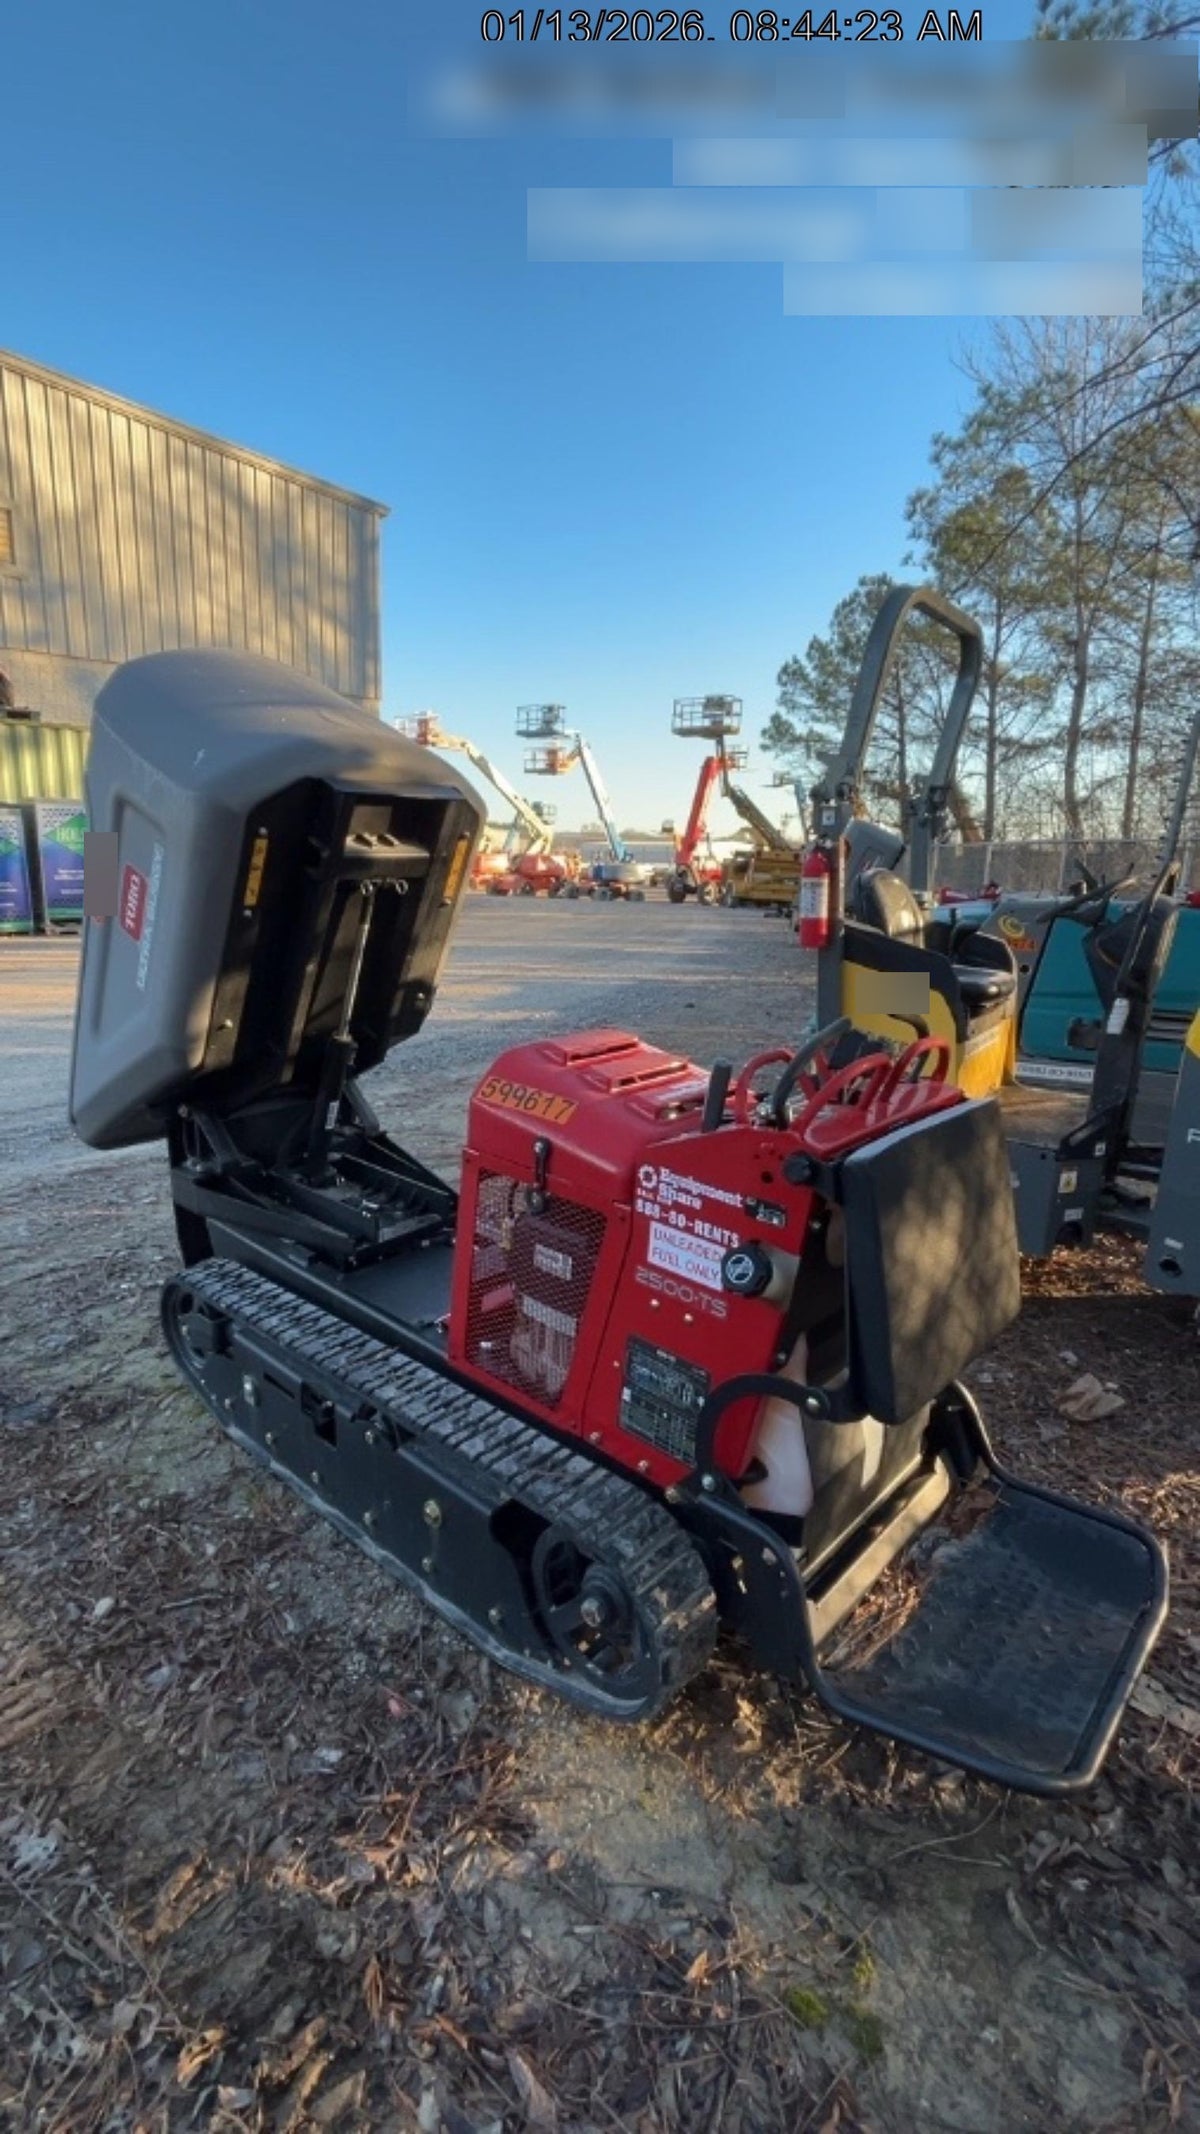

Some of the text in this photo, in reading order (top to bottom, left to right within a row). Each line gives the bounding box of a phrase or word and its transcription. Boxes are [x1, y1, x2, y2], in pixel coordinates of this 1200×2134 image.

[125, 874, 141, 929] TORO
[481, 1078, 576, 1121] 599617
[658, 1166, 744, 1208] Equipment
[658, 1183, 703, 1210] Share
[652, 1247, 720, 1281] FUEL ONLY
[653, 1228, 722, 1262] UNLEADED
